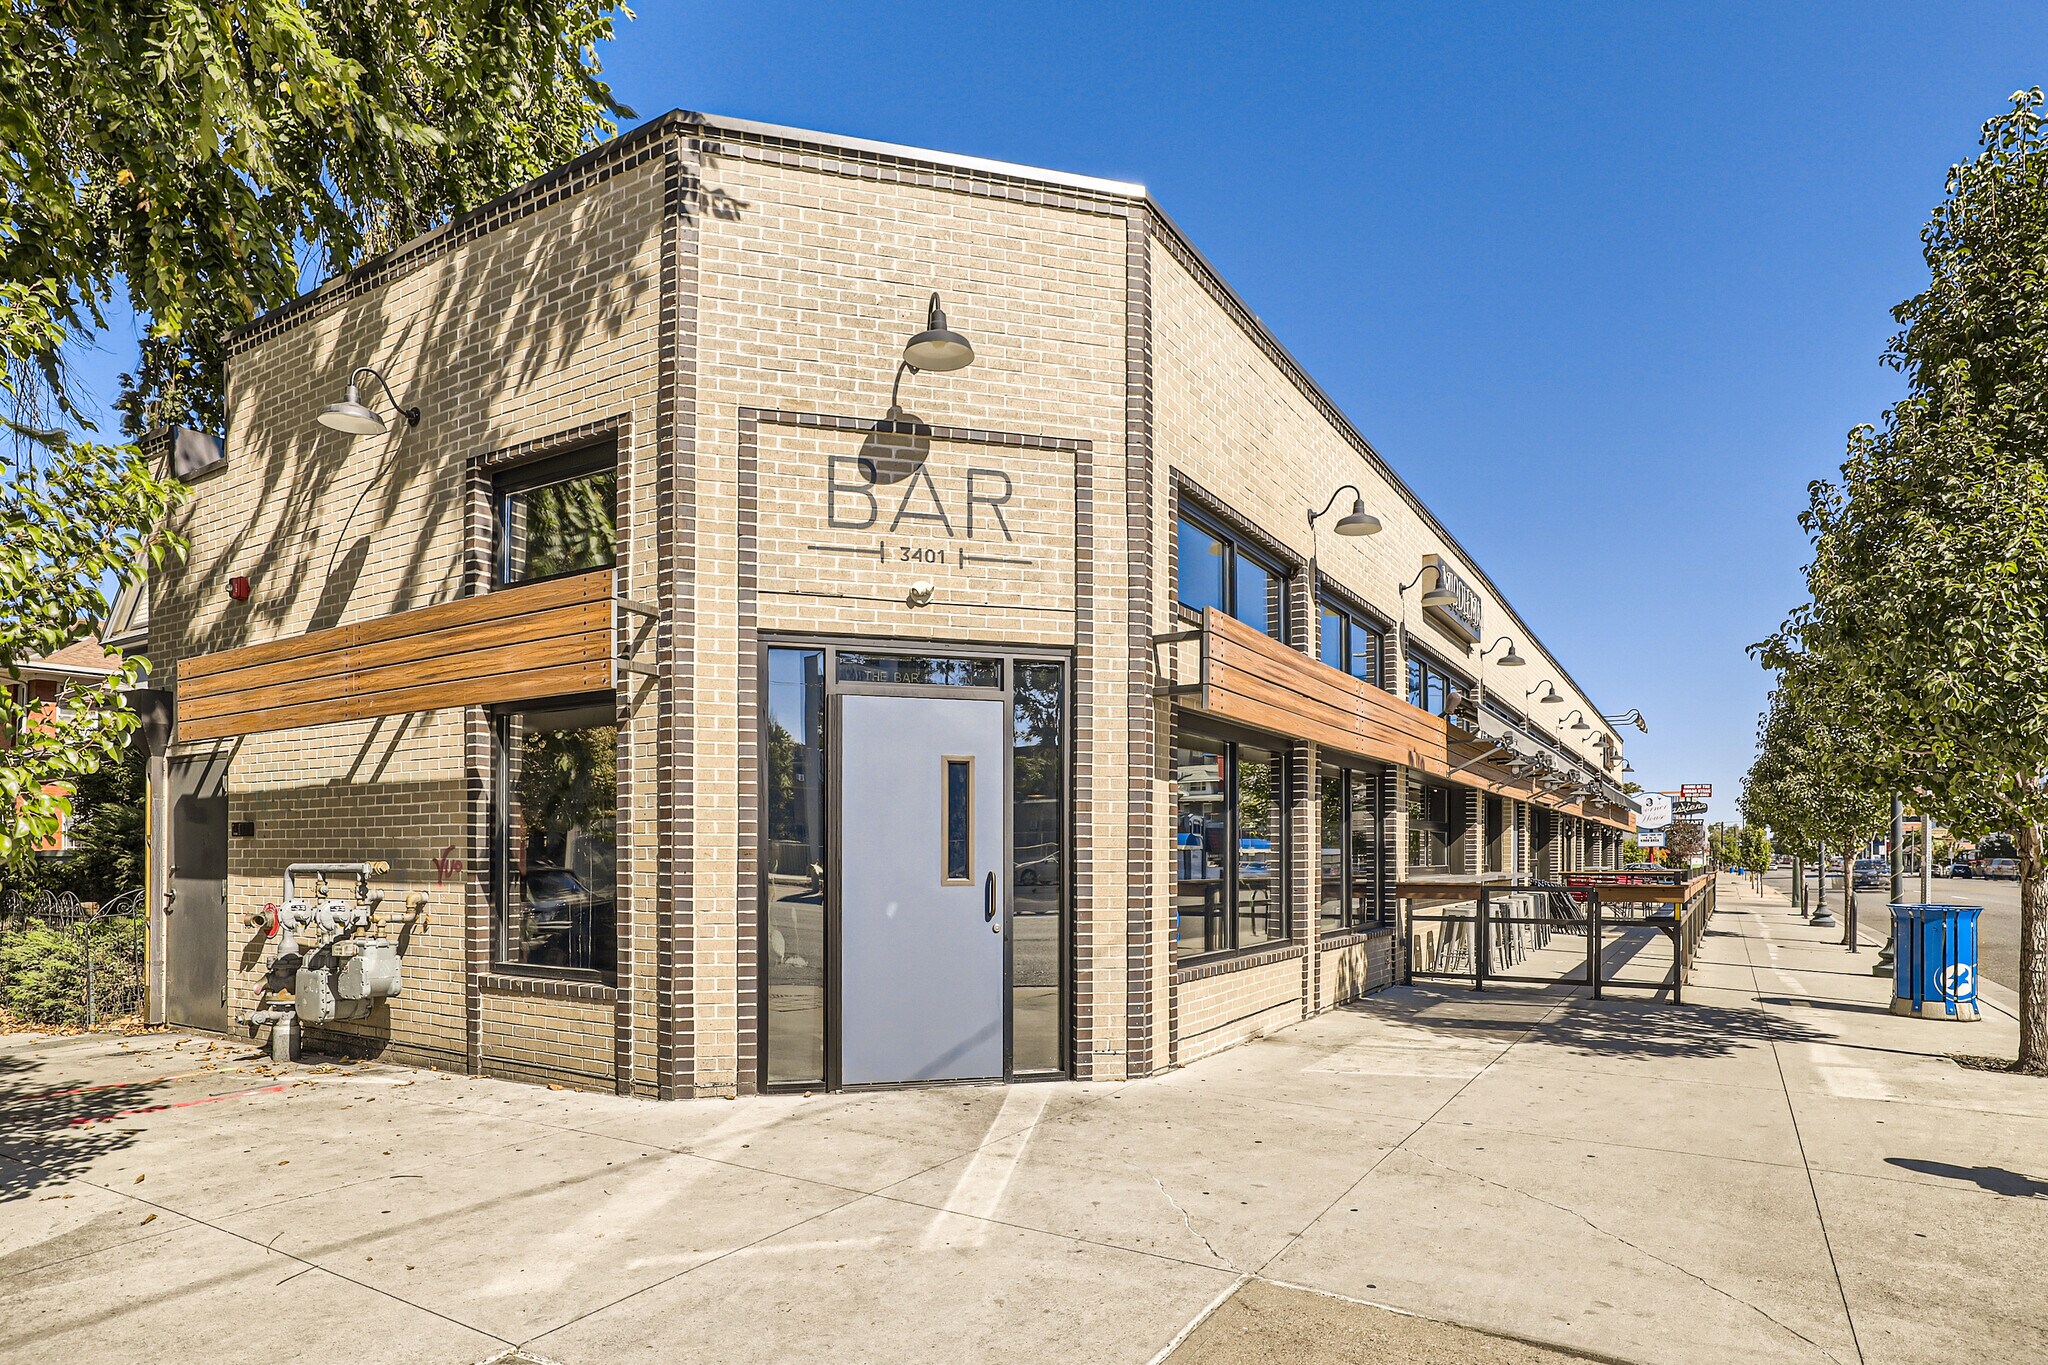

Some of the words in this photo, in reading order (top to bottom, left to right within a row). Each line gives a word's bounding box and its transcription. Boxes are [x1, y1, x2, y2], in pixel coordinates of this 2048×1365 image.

[828, 455, 1013, 541] BAR
[899, 546, 945, 564] 3401
[864, 670, 888, 682] THE
[894, 672, 920, 683] BAR
